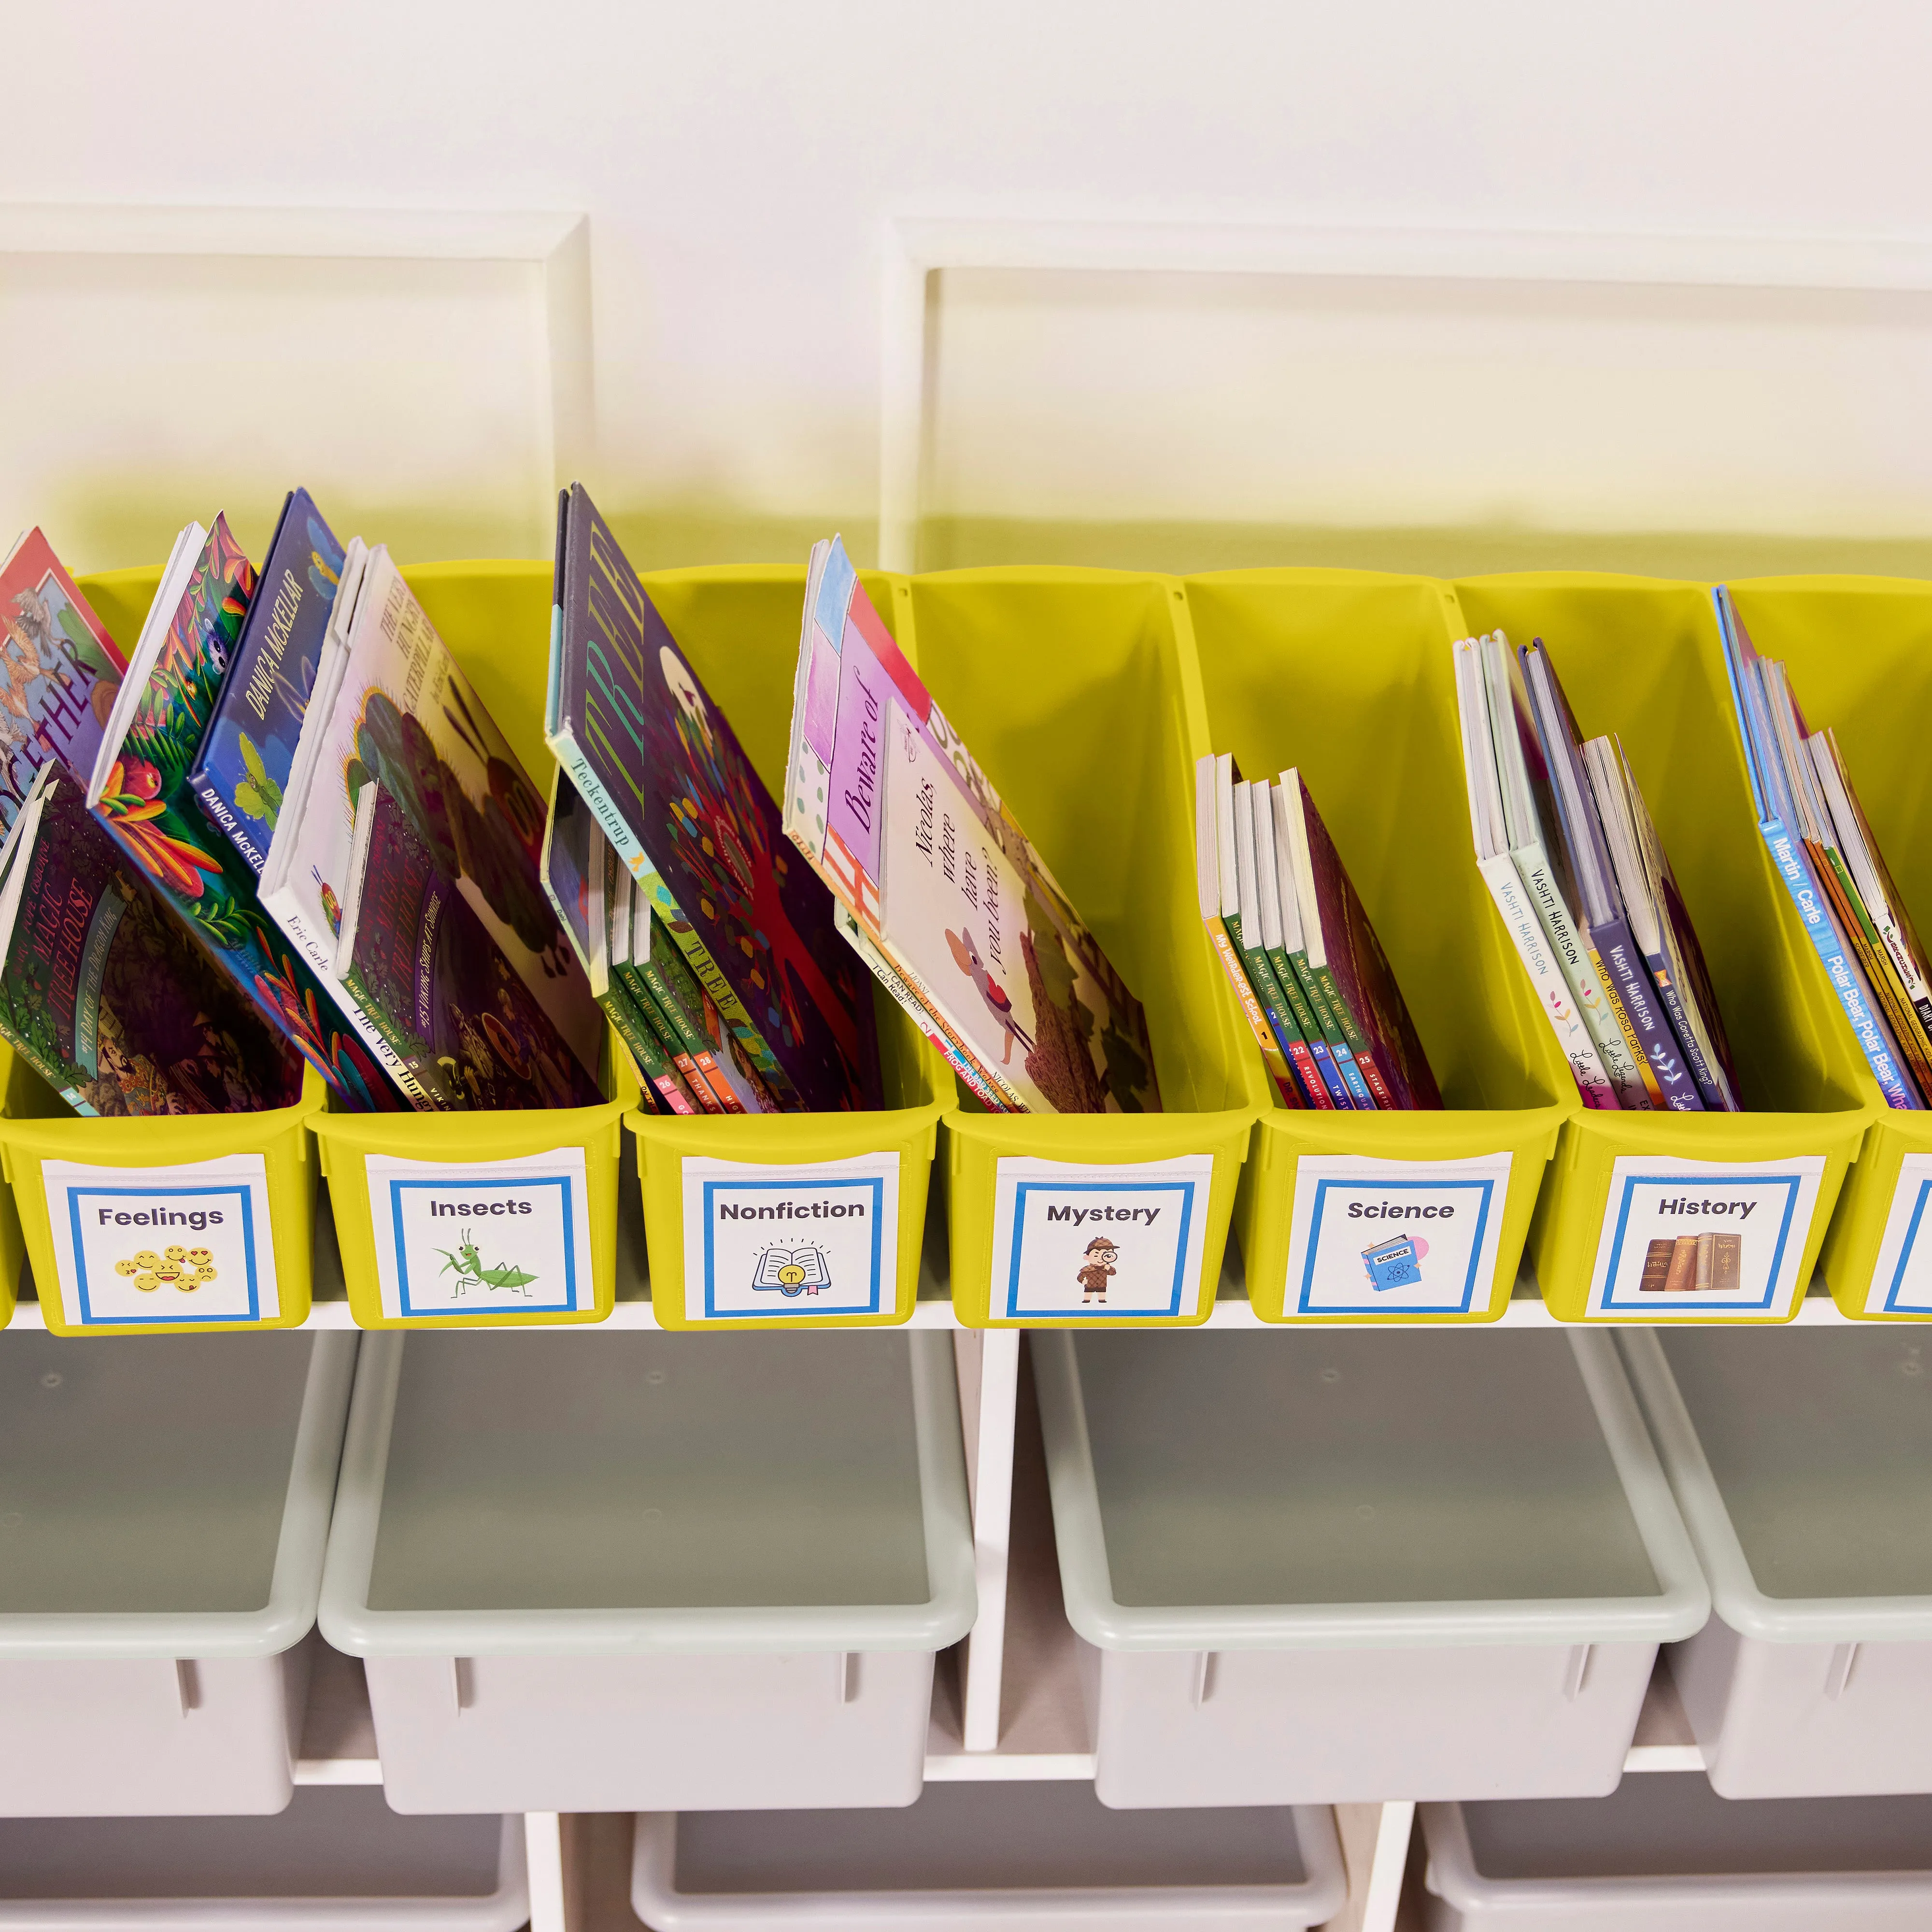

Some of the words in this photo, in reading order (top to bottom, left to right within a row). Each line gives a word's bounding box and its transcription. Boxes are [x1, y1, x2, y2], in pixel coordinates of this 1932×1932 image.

[246, 647, 280, 721] DANICA
[585, 520, 645, 820] TREE
[853, 665, 878, 722] of
[844, 721, 877, 835] Beware
[201, 788, 237, 832] DANICA
[570, 758, 630, 846] Teckentrup
[915, 776, 937, 867] Nicolas,
[938, 813, 955, 884] where
[961, 851, 978, 911] have
[982, 846, 1000, 923] been?
[1773, 837, 1801, 881] Martin
[1797, 889, 1821, 924] Carle
[32, 881, 63, 966] MAGIC
[99, 907, 117, 934] KING
[424, 890, 441, 930] SUNRISE
[556, 909, 567, 922] Dahl
[1500, 881, 1525, 921] VASHTI
[1518, 922, 1548, 976] HARRISON
[1531, 868, 1555, 909] VASHTI
[1548, 910, 1580, 966] HARRISON
[88, 927, 105, 971] DRAGON
[286, 916, 307, 941] Eric
[305, 941, 328, 971] Carle
[424, 923, 433, 945] AT
[988, 919, 1007, 976] you
[1215, 933, 1227, 948] My
[1853, 942, 1870, 968] SCHREIBER
[1863, 943, 1874, 960] MARSH
[419, 938, 432, 974] SHIPS
[685, 940, 738, 1011] TREE
[1876, 949, 1889, 966] MARSH
[85, 990, 95, 1009] OF
[86, 966, 99, 993] THE
[418, 969, 431, 1011] VIKING
[623, 971, 640, 997] MAGIC
[640, 995, 655, 1016] TREE
[644, 969, 666, 995] MAGIC
[662, 994, 678, 1014] TREE
[877, 969, 889, 984] Can
[888, 983, 907, 1005] Read!
[891, 975, 906, 992] CAN
[904, 991, 924, 1014] READ!
[908, 972, 930, 994] LIONNI
[1253, 955, 1271, 981] MAGIC
[1265, 982, 1280, 1002] TREE
[1273, 955, 1291, 981] MAGIC
[1285, 982, 1300, 1002] TREE
[1296, 958, 1314, 984] MAGIC
[1308, 985, 1322, 1005] TREE
[1319, 975, 1337, 999] MAGIC
[1331, 998, 1345, 1017] TREE
[1609, 944, 1634, 981] VASHTI
[1625, 982, 1656, 1031] HARRISON
[345, 979, 368, 1003] MAGIC
[365, 1003, 382, 1021] TREE
[603, 1000, 624, 1023] MAGIC
[621, 1023, 637, 1042] TREE
[1827, 955, 1851, 988] Polar
[1843, 989, 1865, 1022] Bear,
[1858, 1020, 1881, 1052] Polar
[1873, 1052, 1895, 1085] Bear,
[81, 1007, 94, 1036] DAY
[894, 965, 920, 994] Beware
[920, 996, 931, 1006] of
[928, 1008, 940, 1021] the
[941, 1022, 976, 1065] Storybook
[977, 1065, 999, 1094] Wolves
[920, 1021, 932, 1034] 2
[1261, 1031, 1268, 1040] 1
[1605, 982, 1620, 1005] Was
[1615, 1006, 1632, 1033] Rosa
[1627, 1033, 1649, 1066] Parks?
[1665, 990, 1676, 1006] Who
[1672, 1005, 1682, 1020] Was
[1678, 1021, 1694, 1049] Coretta
[1690, 1048, 1705, 1067] Scott
[1698, 1066, 1713, 1085] King?
[1899, 997, 1914, 1020] NATIONAL
[1910, 1019, 1928, 1048] GEOGRAPHIC
[12, 1039, 32, 1057] TREE
[375, 1037, 403, 1068] Very
[678, 1057, 688, 1067] 27
[699, 1056, 711, 1066] 28
[945, 1038, 953, 1048] 1
[1293, 1046, 1305, 1055] 22
[1313, 1045, 1325, 1055] 23
[1335, 1047, 1348, 1057] 24
[1359, 1056, 1371, 1065] 25
[409, 1061, 419, 1070] 15
[659, 1080, 671, 1089] 26
[943, 1050, 963, 1071] FROG
[960, 1069, 976, 1087] AND
[974, 1084, 993, 1107] TOAD
[963, 1061, 976, 1075] THE
[974, 1073, 987, 1089] BAD
[984, 1087, 1002, 1105] SEED
[1369, 1073, 1385, 1096] STAGE
[1570, 1049, 1593, 1077] Little
[1582, 1076, 1606, 1110] Leaders
[1598, 1037, 1621, 1064] Little
[1612, 1062, 1634, 1094] Legends
[99, 1208, 223, 1230] Feelings
[431, 1200, 532, 1216] Insects
[721, 1201, 864, 1219] Nonfiction
[1048, 1206, 1161, 1226] Mystery
[1348, 1202, 1454, 1218] Science
[1659, 1198, 1757, 1219] History
[1377, 1249, 1409, 1263] SCIENCE
